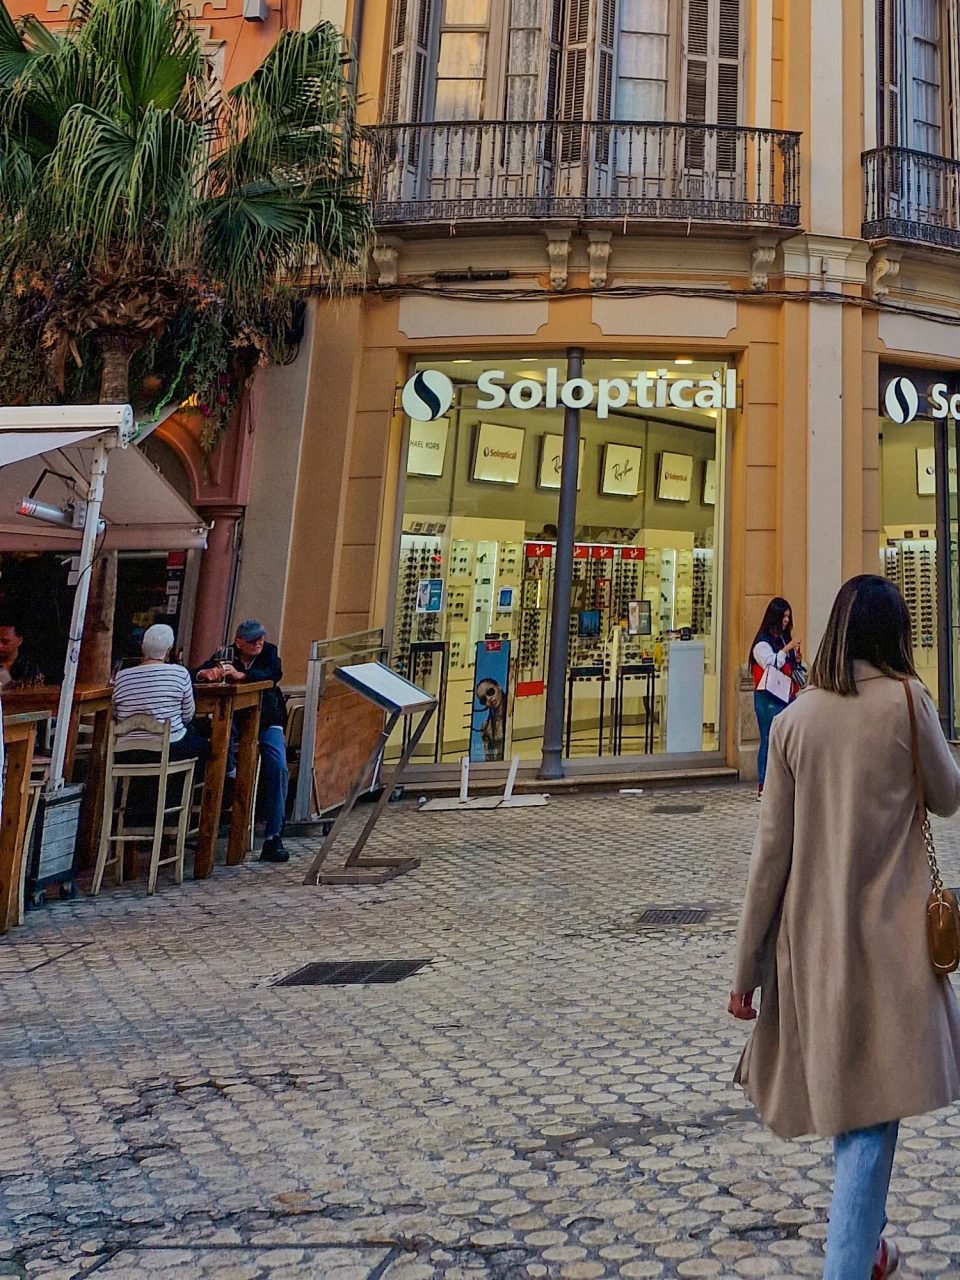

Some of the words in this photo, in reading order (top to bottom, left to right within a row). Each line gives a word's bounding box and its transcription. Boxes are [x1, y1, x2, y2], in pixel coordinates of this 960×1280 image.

[476, 368, 736, 418] Soloptical
[425, 441, 440, 450] KORS
[489, 448, 518, 461] Soloptical
